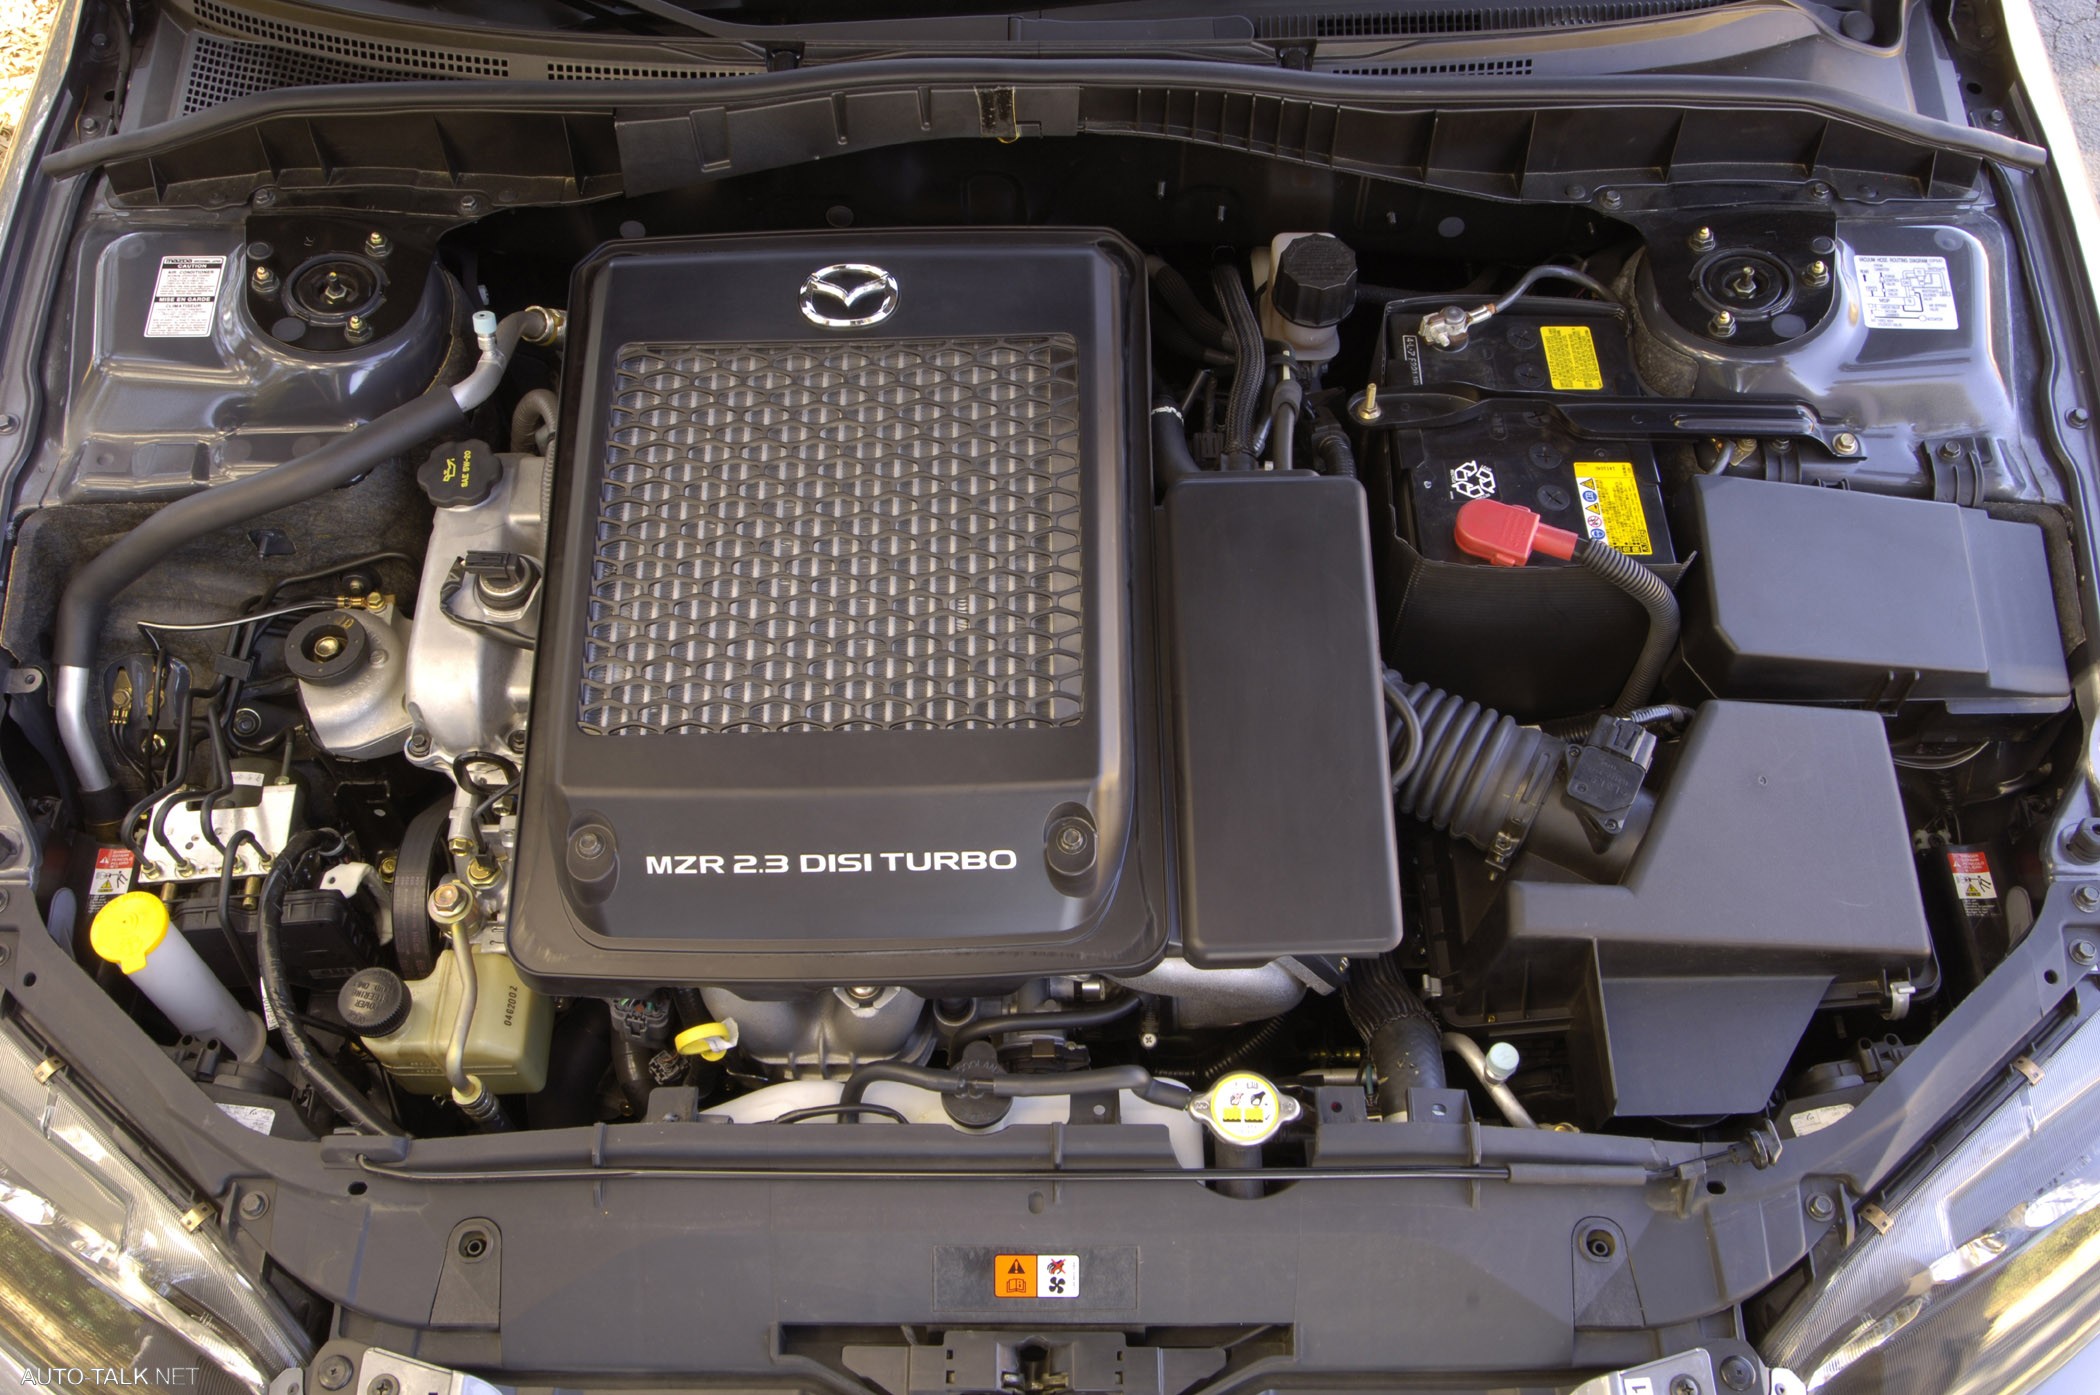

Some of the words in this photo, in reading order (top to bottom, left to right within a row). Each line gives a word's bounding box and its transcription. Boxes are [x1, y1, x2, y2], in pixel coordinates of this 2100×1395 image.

[645, 855, 725, 875] MZR
[733, 855, 789, 874] 2.3
[800, 853, 872, 873] DISI
[880, 849, 1017, 872] TURBO
